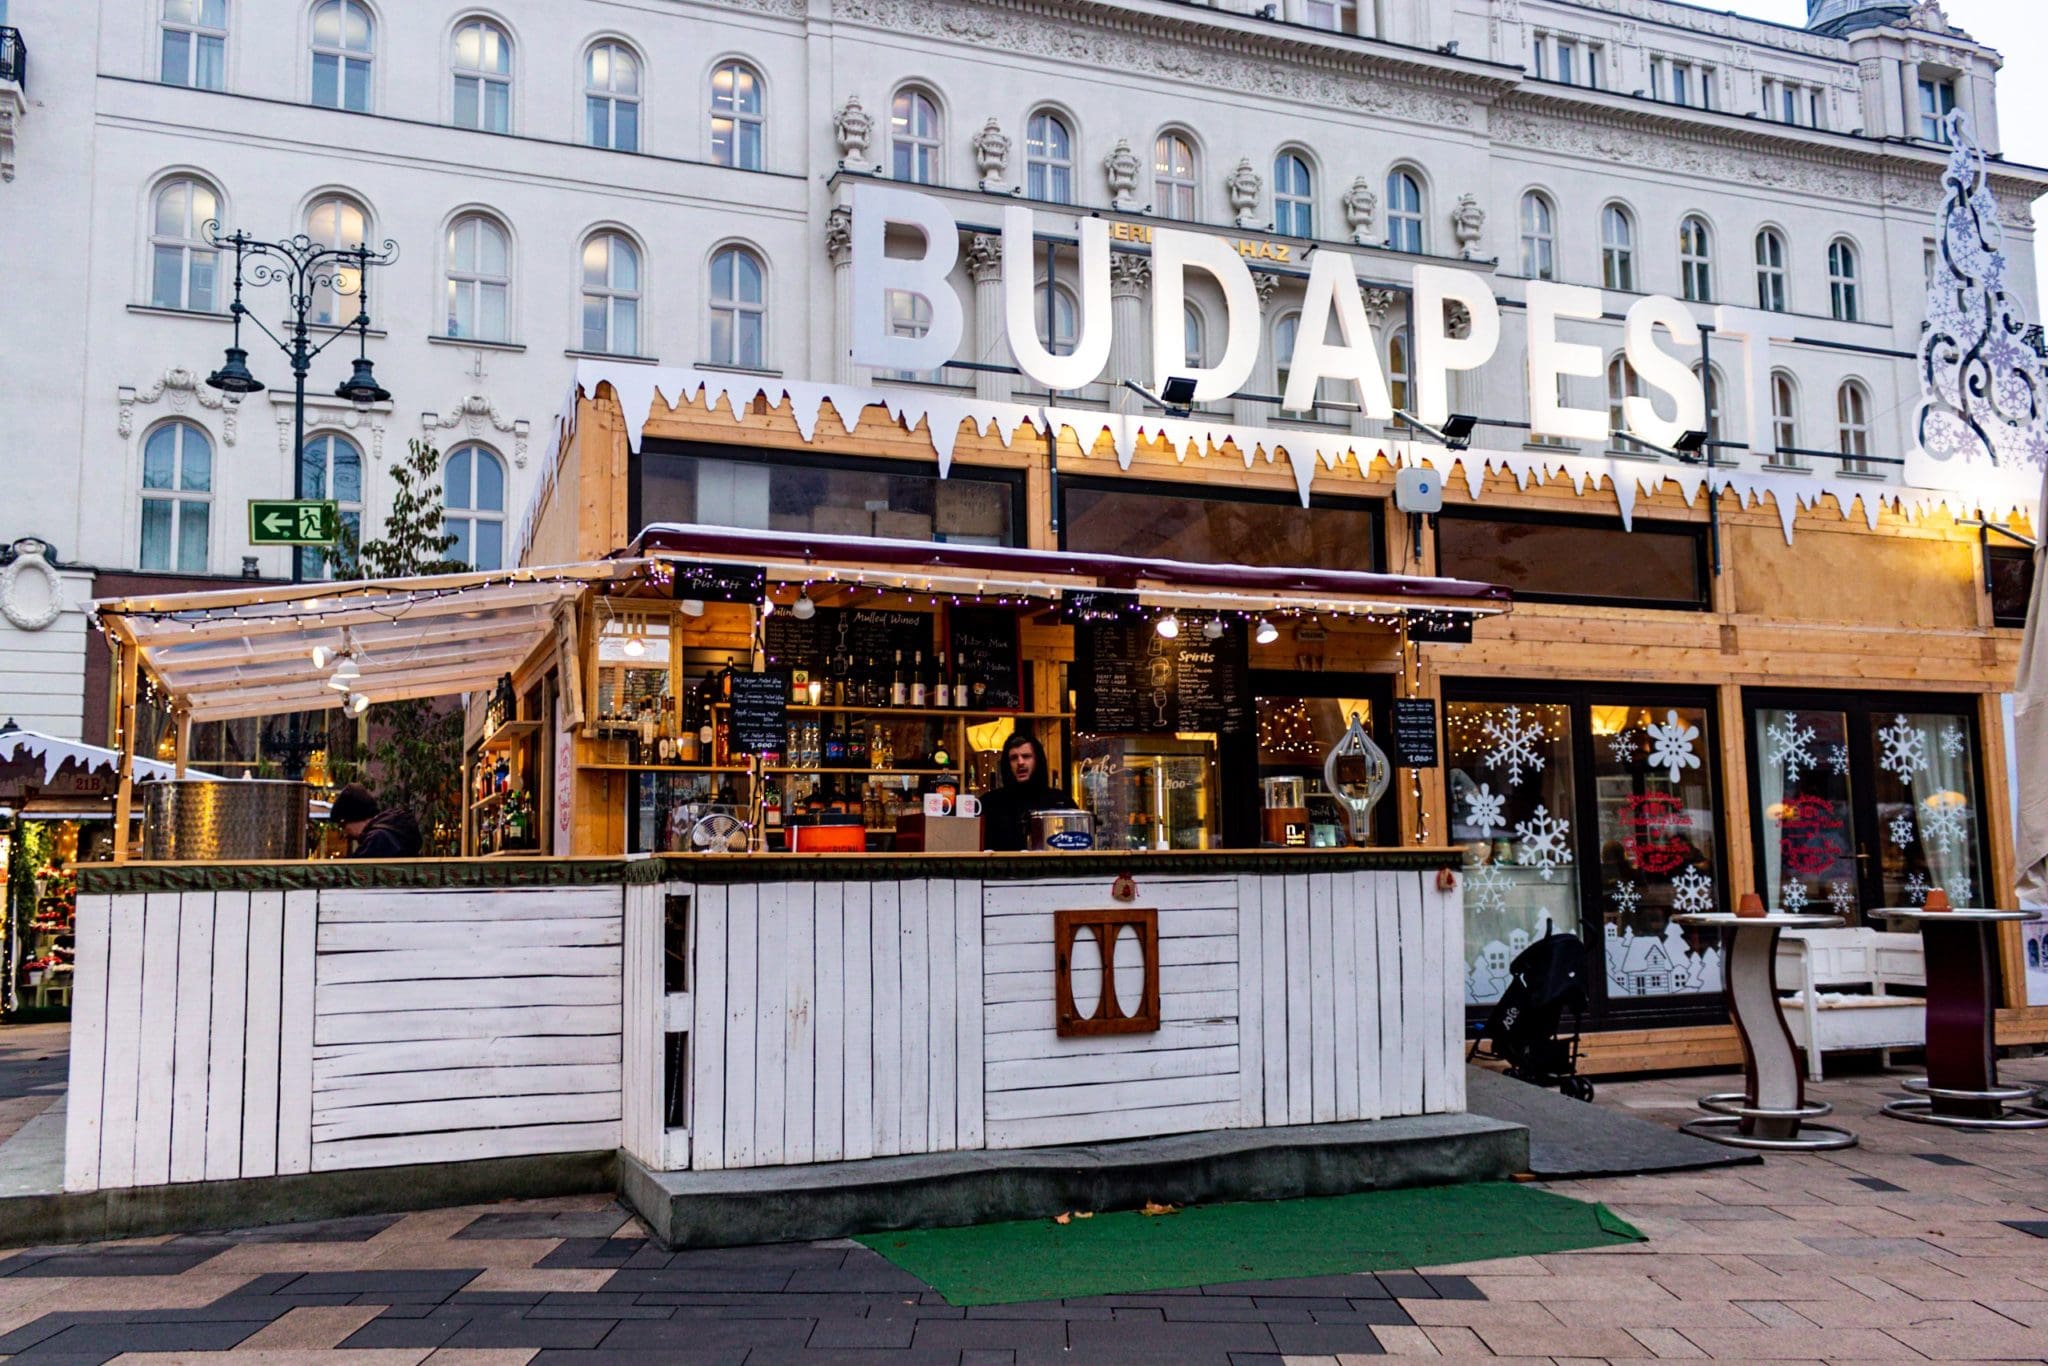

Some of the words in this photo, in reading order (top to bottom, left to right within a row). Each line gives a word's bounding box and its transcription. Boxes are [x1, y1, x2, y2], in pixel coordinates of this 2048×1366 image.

[851, 182, 1796, 456] BUDAPEST
[853, 611, 887, 627] Mulled
[1178, 650, 1217, 663] Spirits
[1079, 754, 1133, 779] Cake
[75, 777, 101, 791] 21B
